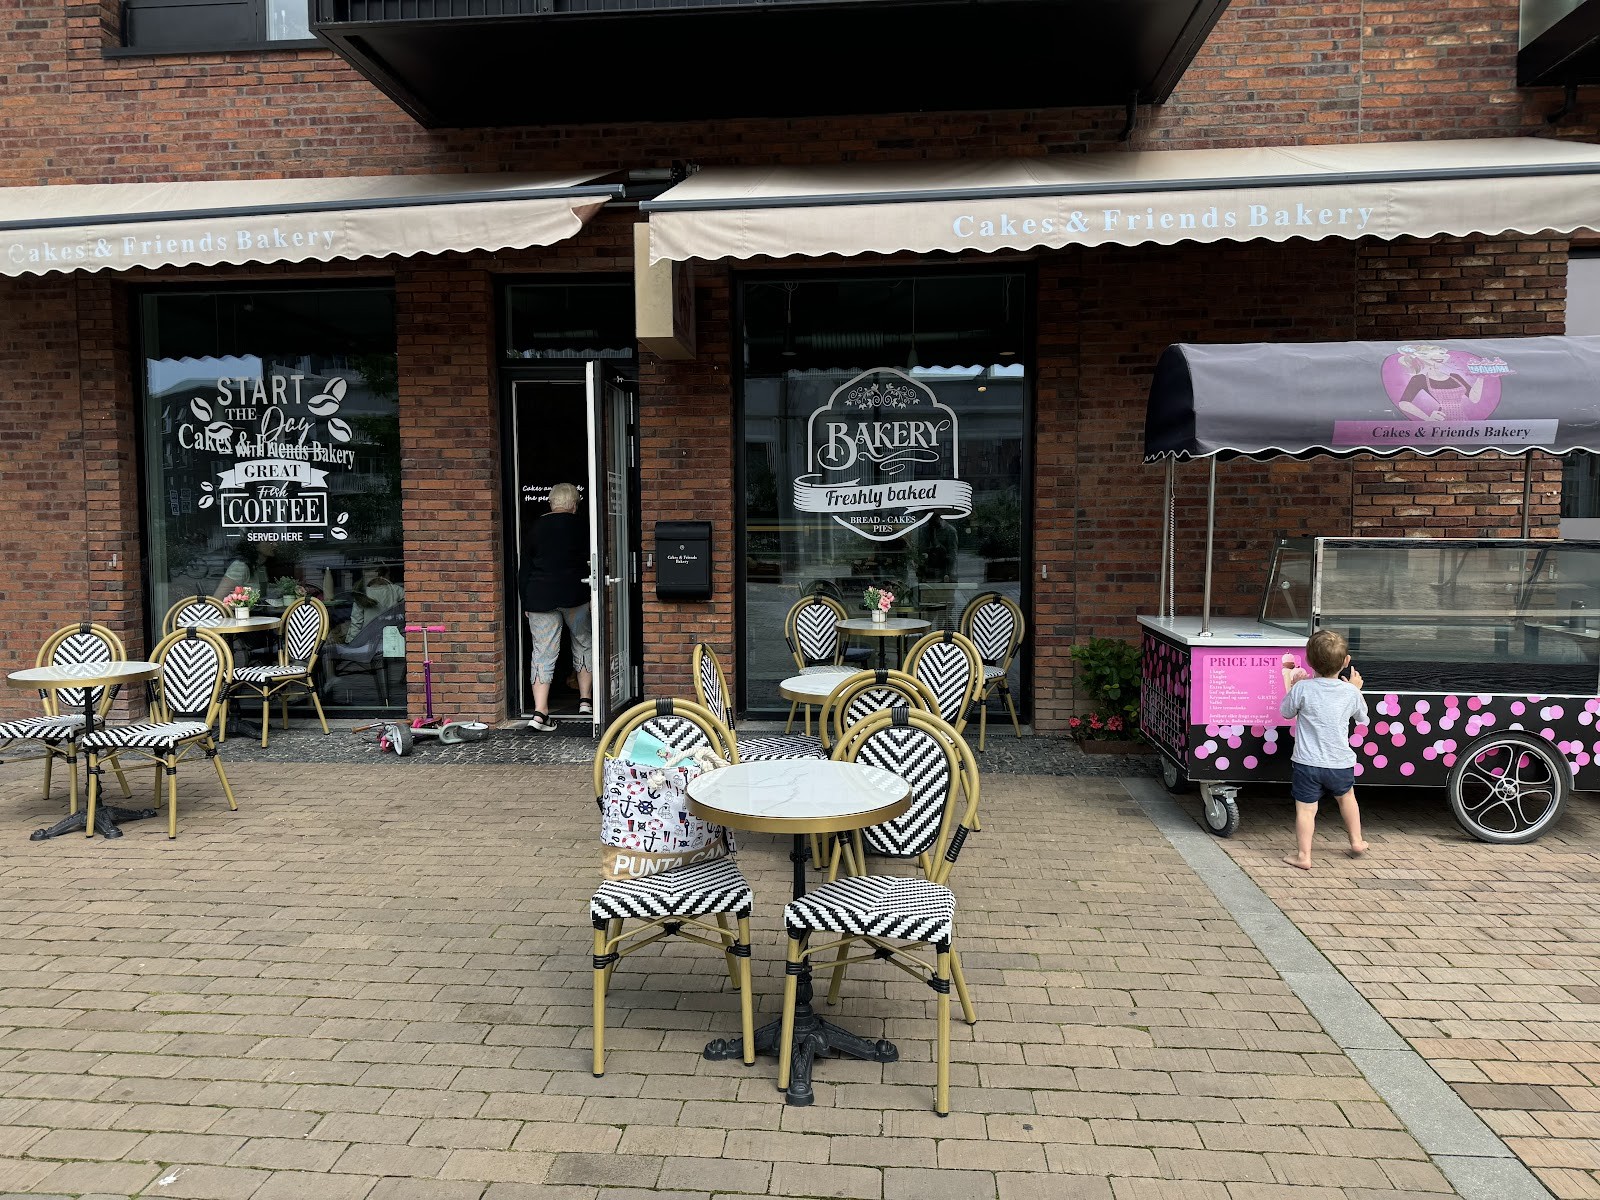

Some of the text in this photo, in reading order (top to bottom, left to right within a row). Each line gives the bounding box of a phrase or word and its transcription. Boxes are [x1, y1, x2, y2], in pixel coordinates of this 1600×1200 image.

[952, 203, 1375, 238] Cakes & Friends Bakery
[8, 228, 336, 265] Cakes & Friends Bakery
[216, 375, 305, 406] START
[225, 406, 315, 445] THE Day
[1372, 426, 1531, 440] Cakes & Friends Bakery
[178, 423, 233, 452] Cakes
[312, 441, 355, 470] Bakery
[244, 464, 301, 478] GREAT
[825, 484, 938, 508] Freshly baked
[228, 498, 320, 523] COFFEE
[850, 516, 880, 524] BREAD
[887, 515, 916, 524] CAKES
[247, 532, 303, 542] SERVED HERE
[873, 525, 893, 533] PIES
[1210, 657, 1278, 667] PRICE LIST
[613, 854, 684, 878] PUNTA
